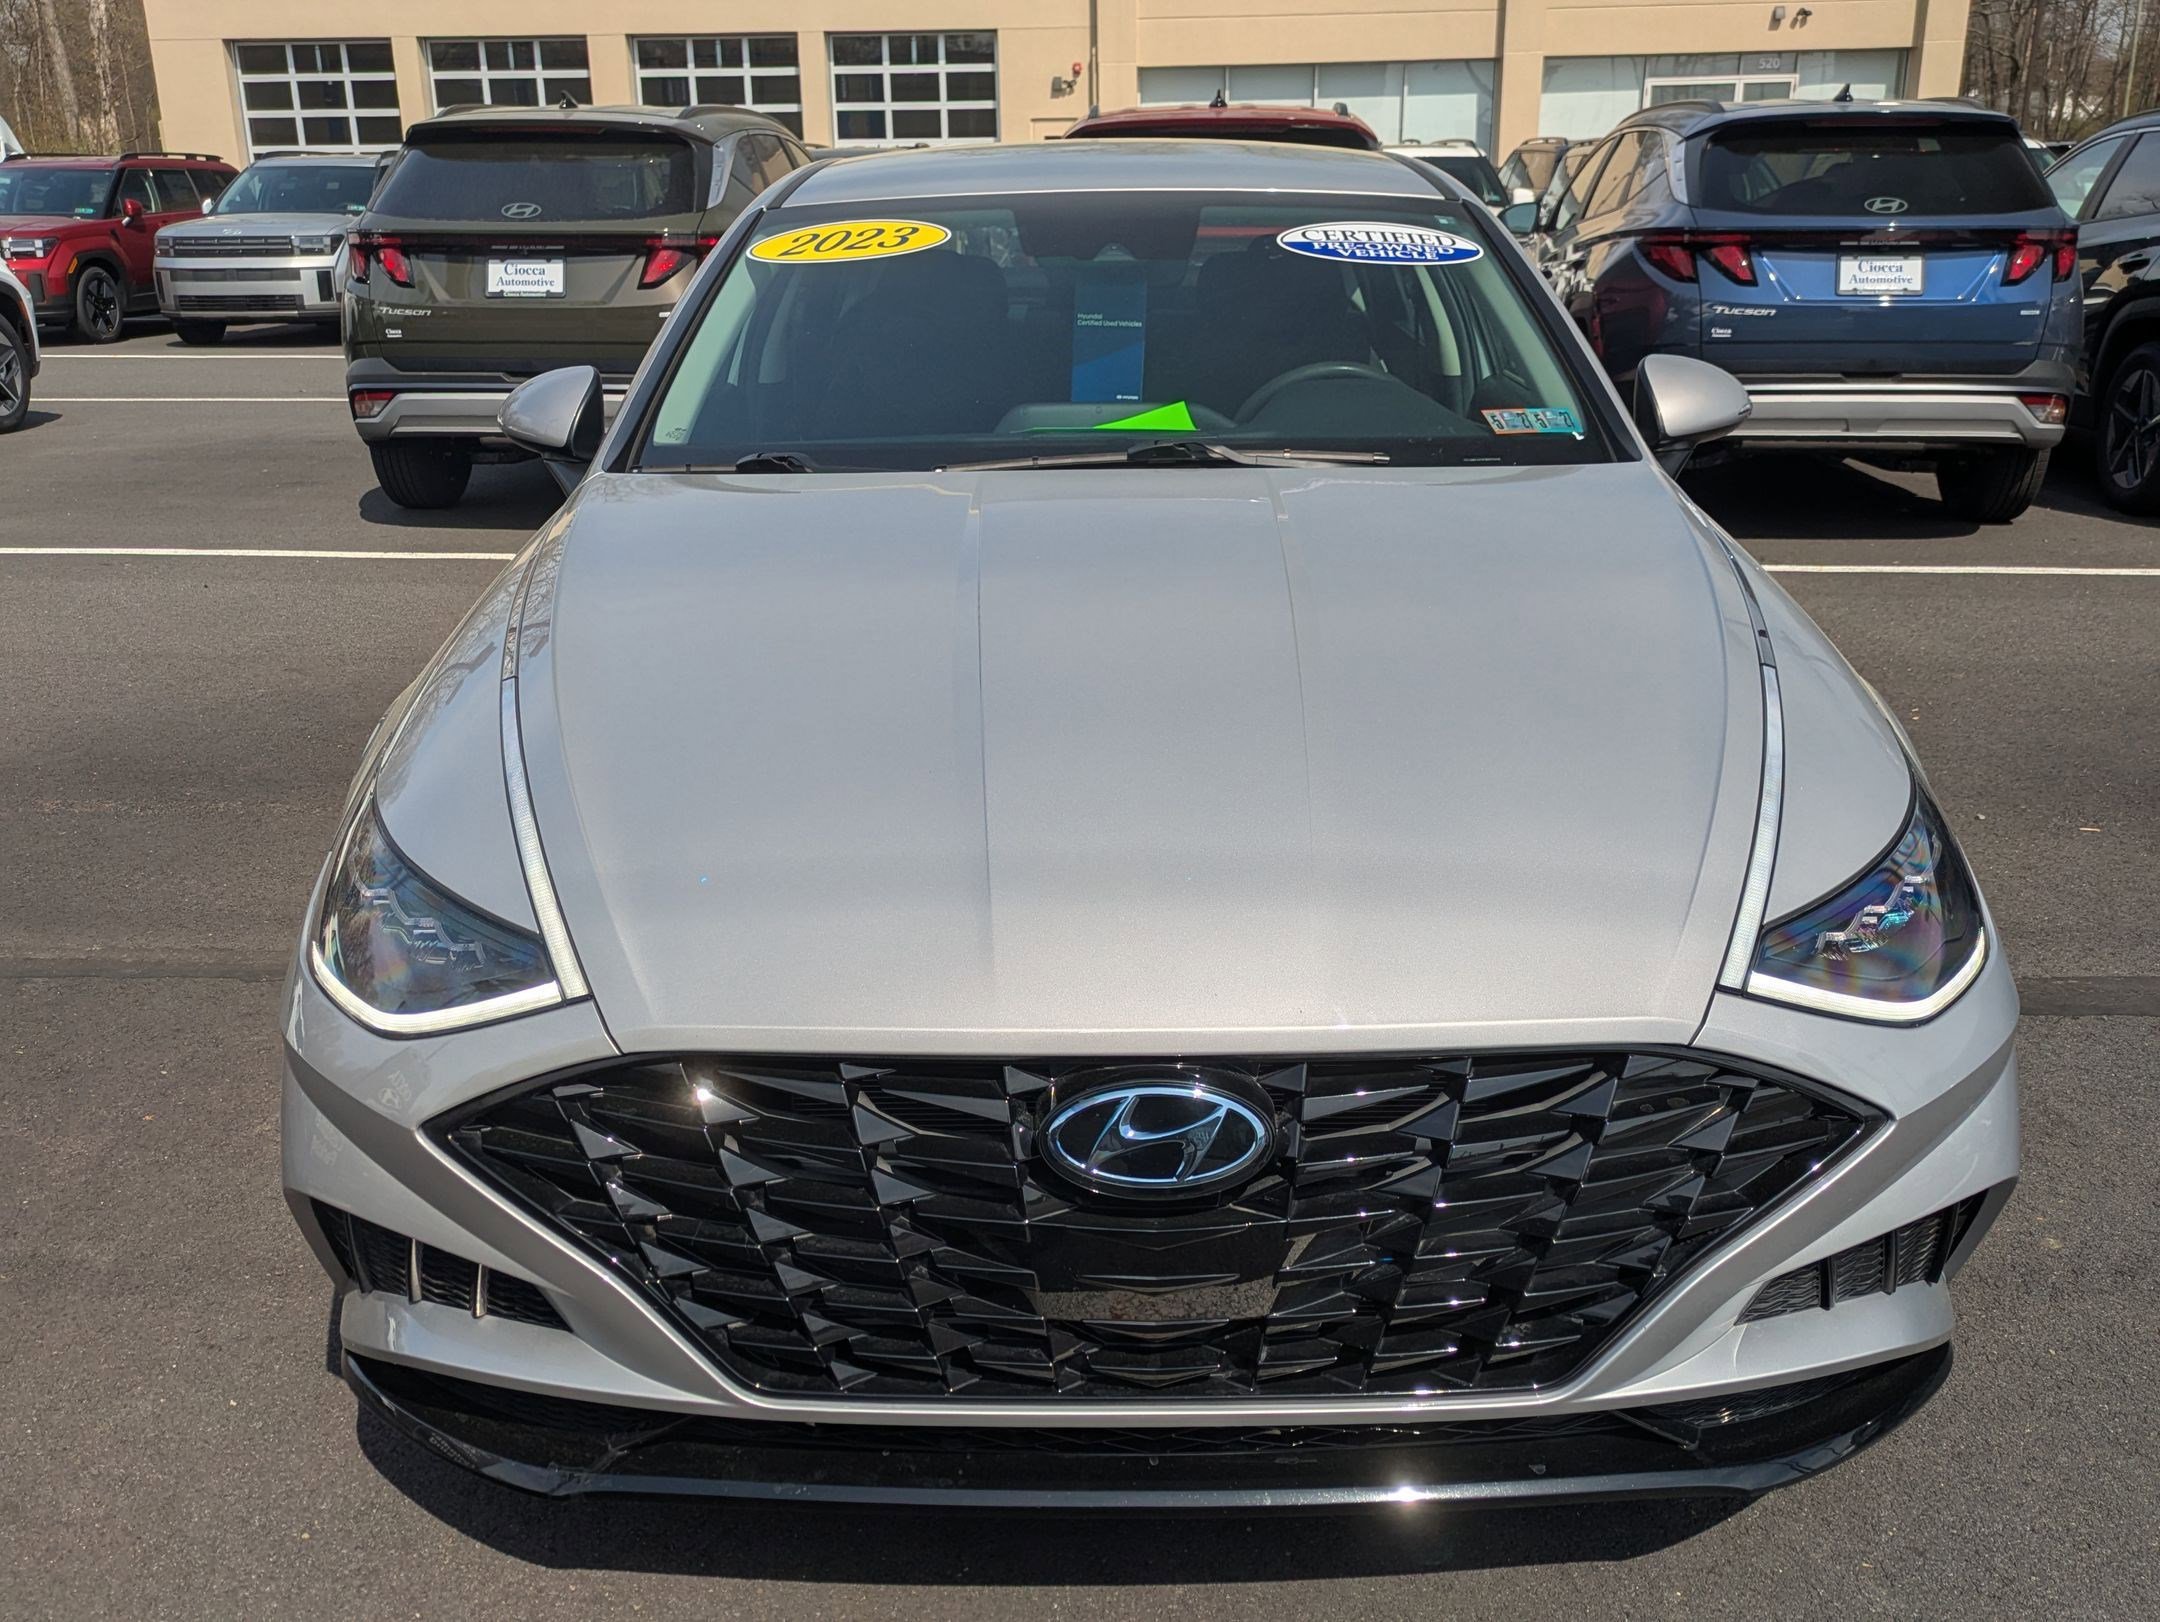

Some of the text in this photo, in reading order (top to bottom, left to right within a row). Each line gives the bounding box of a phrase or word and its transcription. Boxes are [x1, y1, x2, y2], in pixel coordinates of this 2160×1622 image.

[1759, 57, 1780, 69] 520
[776, 226, 920, 257] 2023
[1301, 229, 1457, 247] CERTIFIED
[1313, 241, 1455, 254] PRE-OWNED
[1335, 248, 1439, 261] VEHICLE
[504, 262, 546, 275] Ciocca
[1858, 259, 1903, 273] Ciocca
[496, 276, 556, 287] Automotive
[1849, 274, 1914, 285] Automotive
